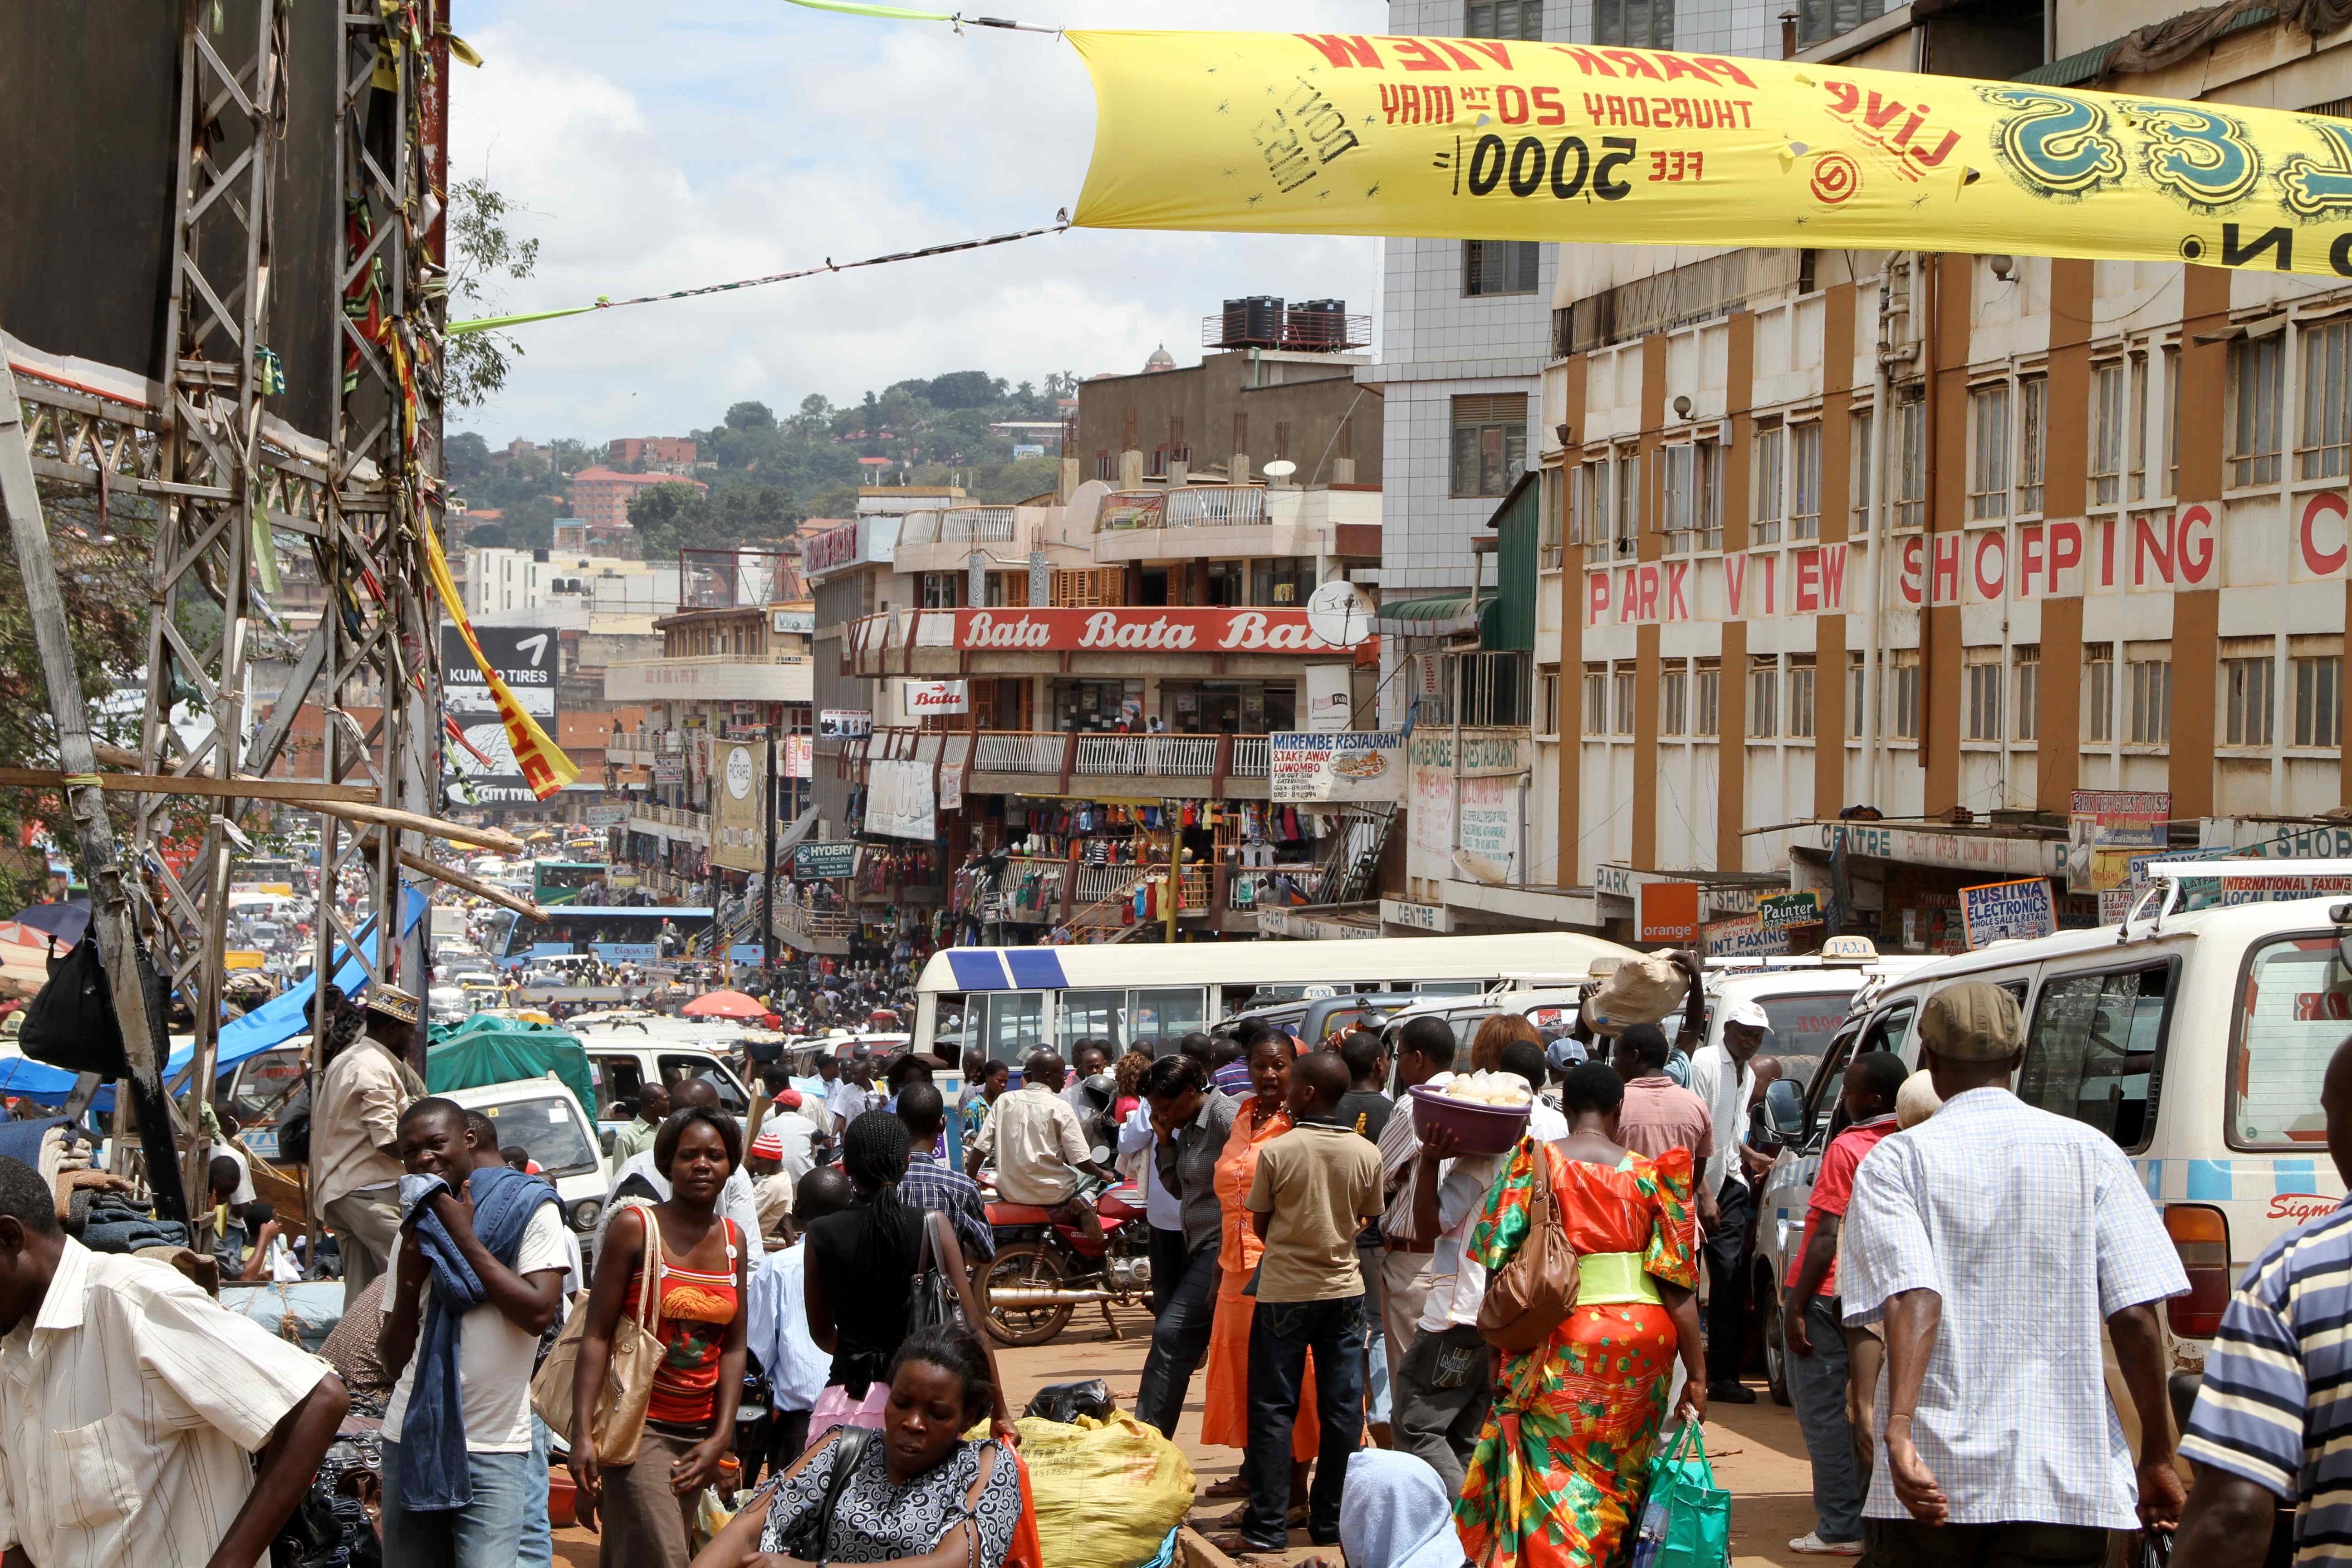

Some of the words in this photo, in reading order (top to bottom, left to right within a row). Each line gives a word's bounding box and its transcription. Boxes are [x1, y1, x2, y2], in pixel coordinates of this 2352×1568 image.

[1590, 563, 1688, 625] PARK
[1725, 545, 1847, 616] VIEW
[1900, 504, 2214, 604] SHOPPING
[963, 612, 1051, 648] Bata
[1078, 611, 1197, 648] Bata
[1218, 612, 1357, 651] Ba
[450, 669, 505, 683] KUMO
[510, 669, 548, 683] TIRES
[914, 692, 961, 706] Bata
[1274, 734, 1333, 750] MIREMBE
[1336, 733, 1402, 749] RESTAURANT
[1305, 751, 1332, 762] AWAY
[1408, 740, 1452, 767] MIREMBE
[1463, 740, 1519, 768] RESTAURANT
[1274, 763, 1320, 773] LUWOMBO
[481, 788, 507, 802] CITY
[2072, 794, 2094, 813] PARK
[2114, 795, 2140, 813] GUEST
[2140, 795, 2168, 813] HOUSE
[2277, 827, 2352, 858] SHOP
[811, 844, 852, 857] HYDERY
[1964, 841, 1988, 862] LUWUM
[1597, 868, 1629, 894] PARK
[2223, 877, 2307, 891] INTERNATIONAL
[2311, 877, 2351, 891] FAXING
[2224, 891, 2264, 906] LOCAL
[1398, 903, 1434, 927] CENTRE
[1764, 902, 1814, 920] Painter
[1968, 897, 2048, 921] ELECTRONICS
[2021, 911, 2048, 922] RETAIL
[1266, 910, 1284, 929] PARK
[1302, 921, 1321, 940] VIEW
[1644, 925, 1692, 938] orange
[1723, 927, 1754, 938] CENTER
[1737, 929, 1788, 949] FAXING
[614, 946, 641, 958] Elgon
[1831, 941, 1868, 954] TAXI
[1308, 988, 1335, 998] TAXI
